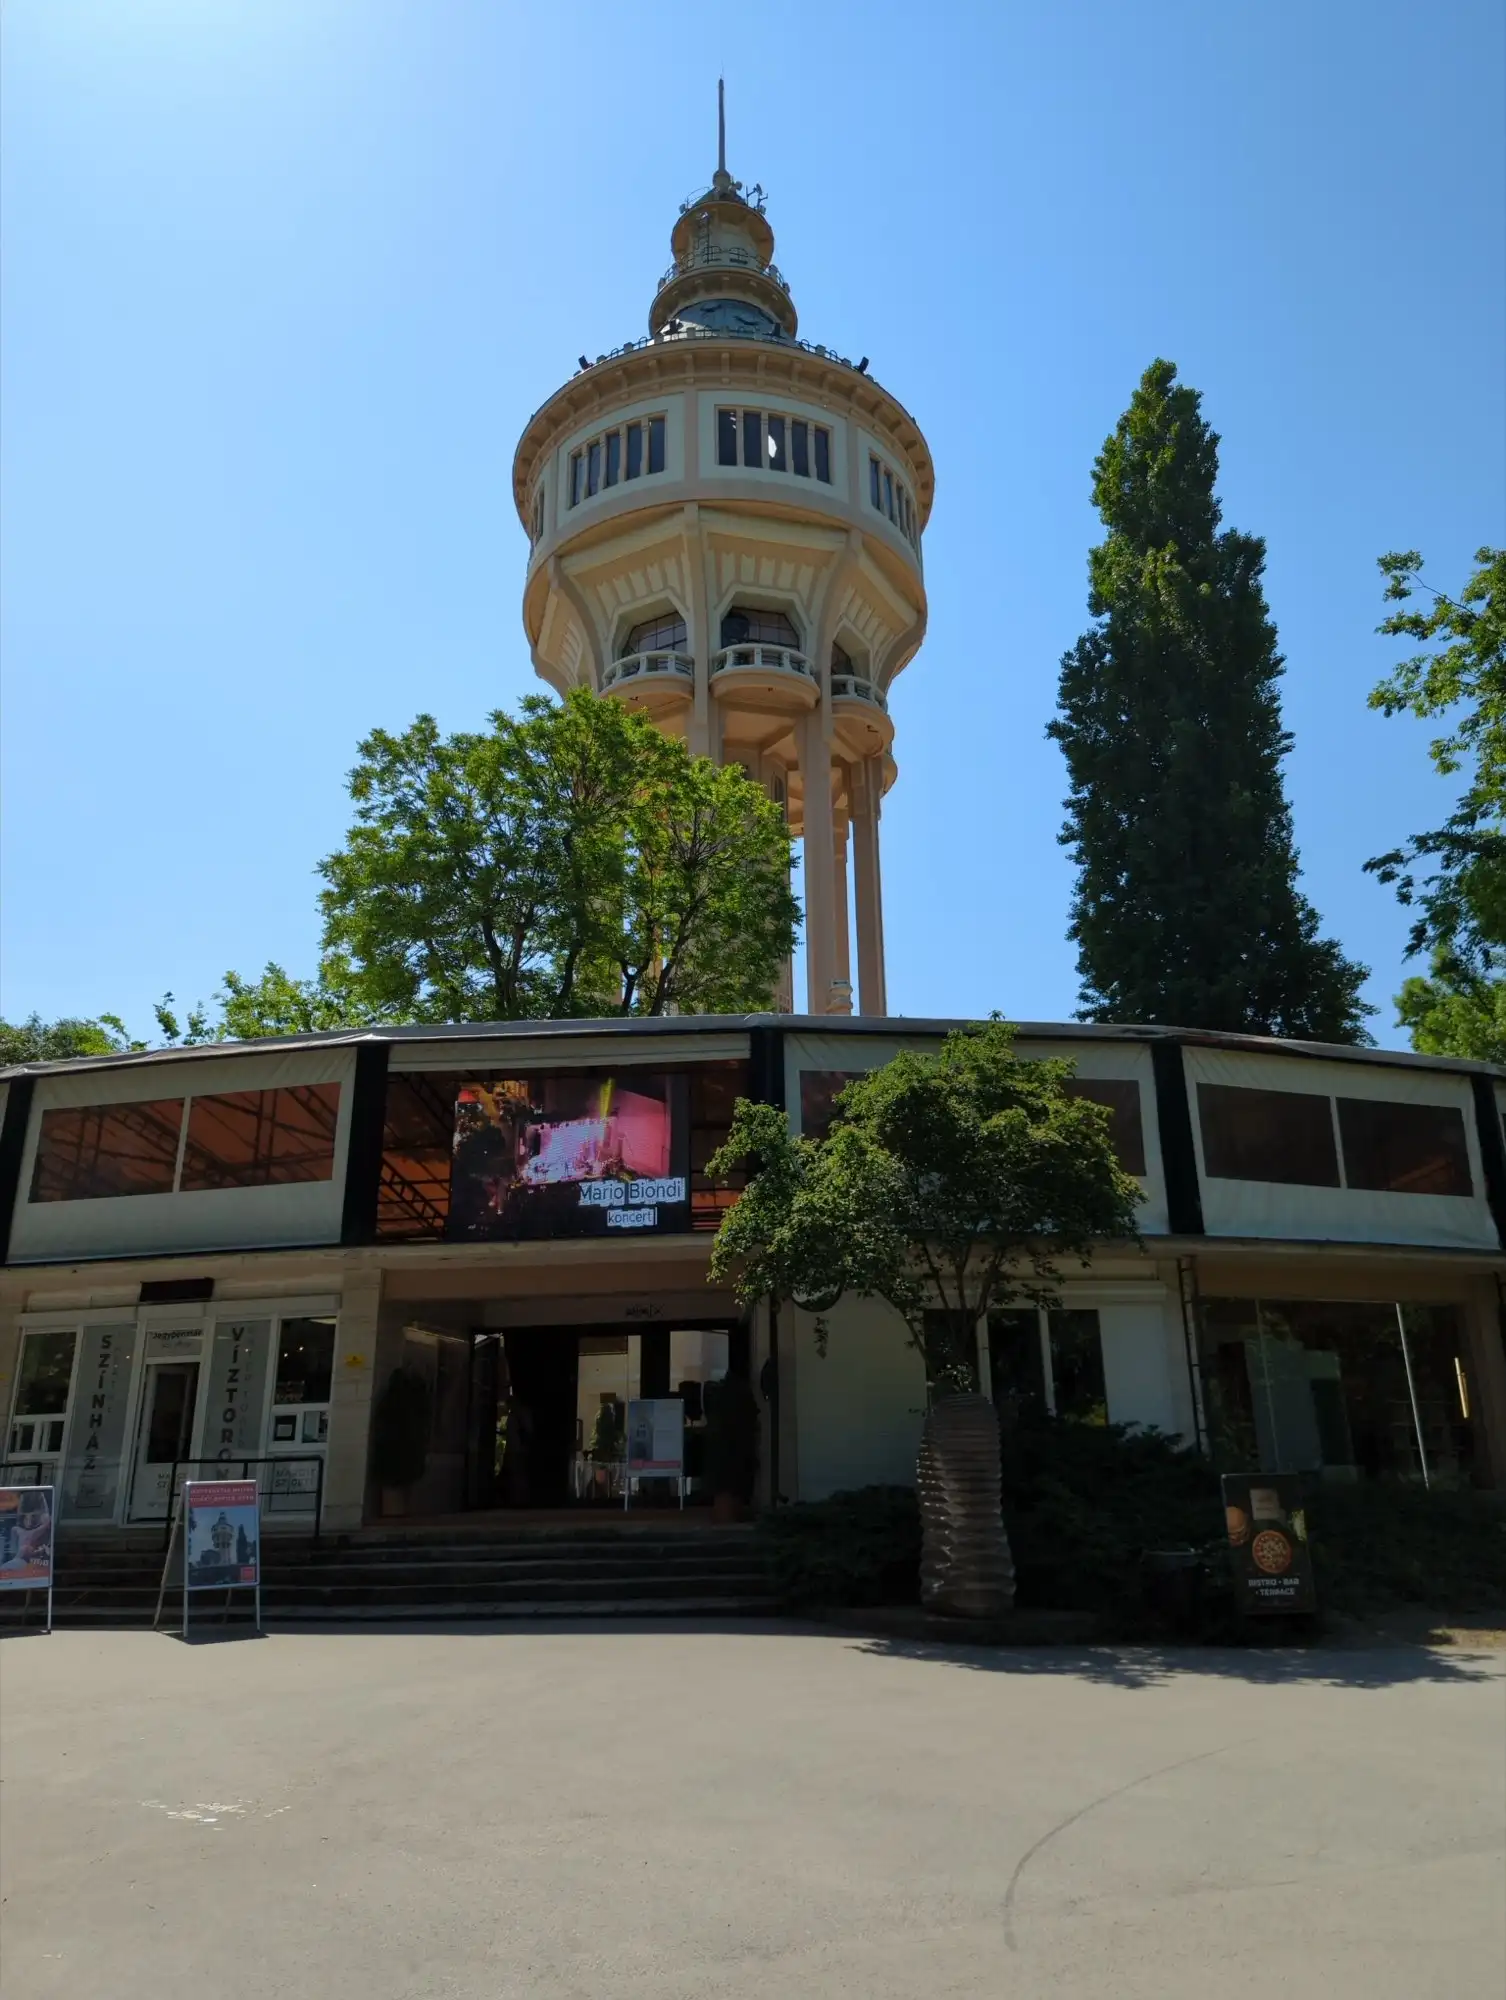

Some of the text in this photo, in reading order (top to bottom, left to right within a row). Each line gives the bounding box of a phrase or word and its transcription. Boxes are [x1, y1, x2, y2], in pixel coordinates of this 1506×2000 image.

[579, 1182, 681, 1200] Mario Biondi
[608, 1211, 652, 1223] koncert
[83, 1334, 114, 1471] SZÍNHÁZ
[1282, 1577, 1300, 1585] BAR
